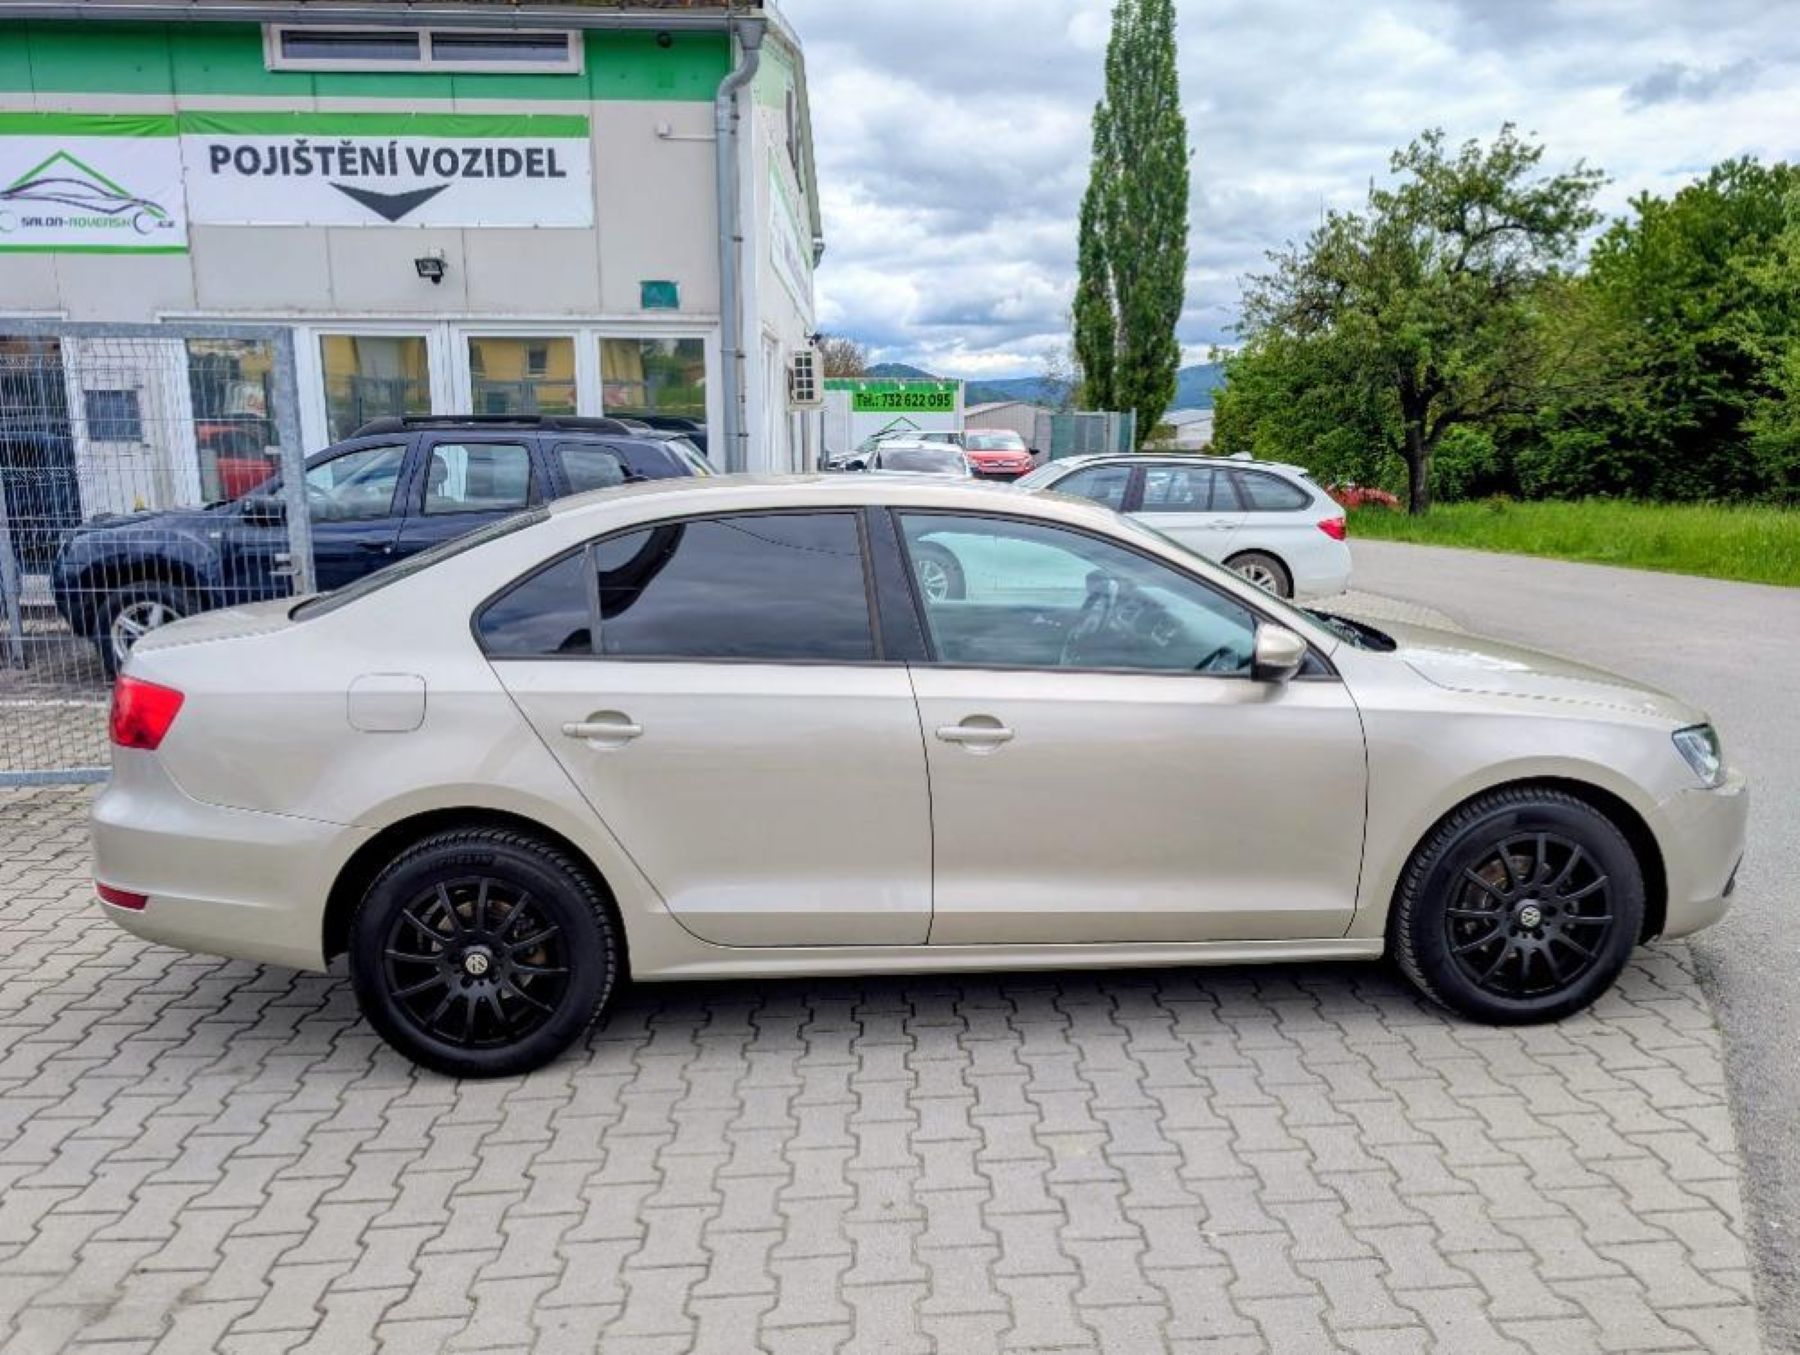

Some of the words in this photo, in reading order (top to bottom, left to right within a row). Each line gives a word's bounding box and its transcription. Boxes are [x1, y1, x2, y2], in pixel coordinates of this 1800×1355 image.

[209, 139, 398, 177] POJIŠTĚNÍ
[405, 147, 568, 178] VOZIDEL
[882, 393, 902, 407] 732
[904, 393, 926, 407] 622
[928, 393, 951, 407] 095
